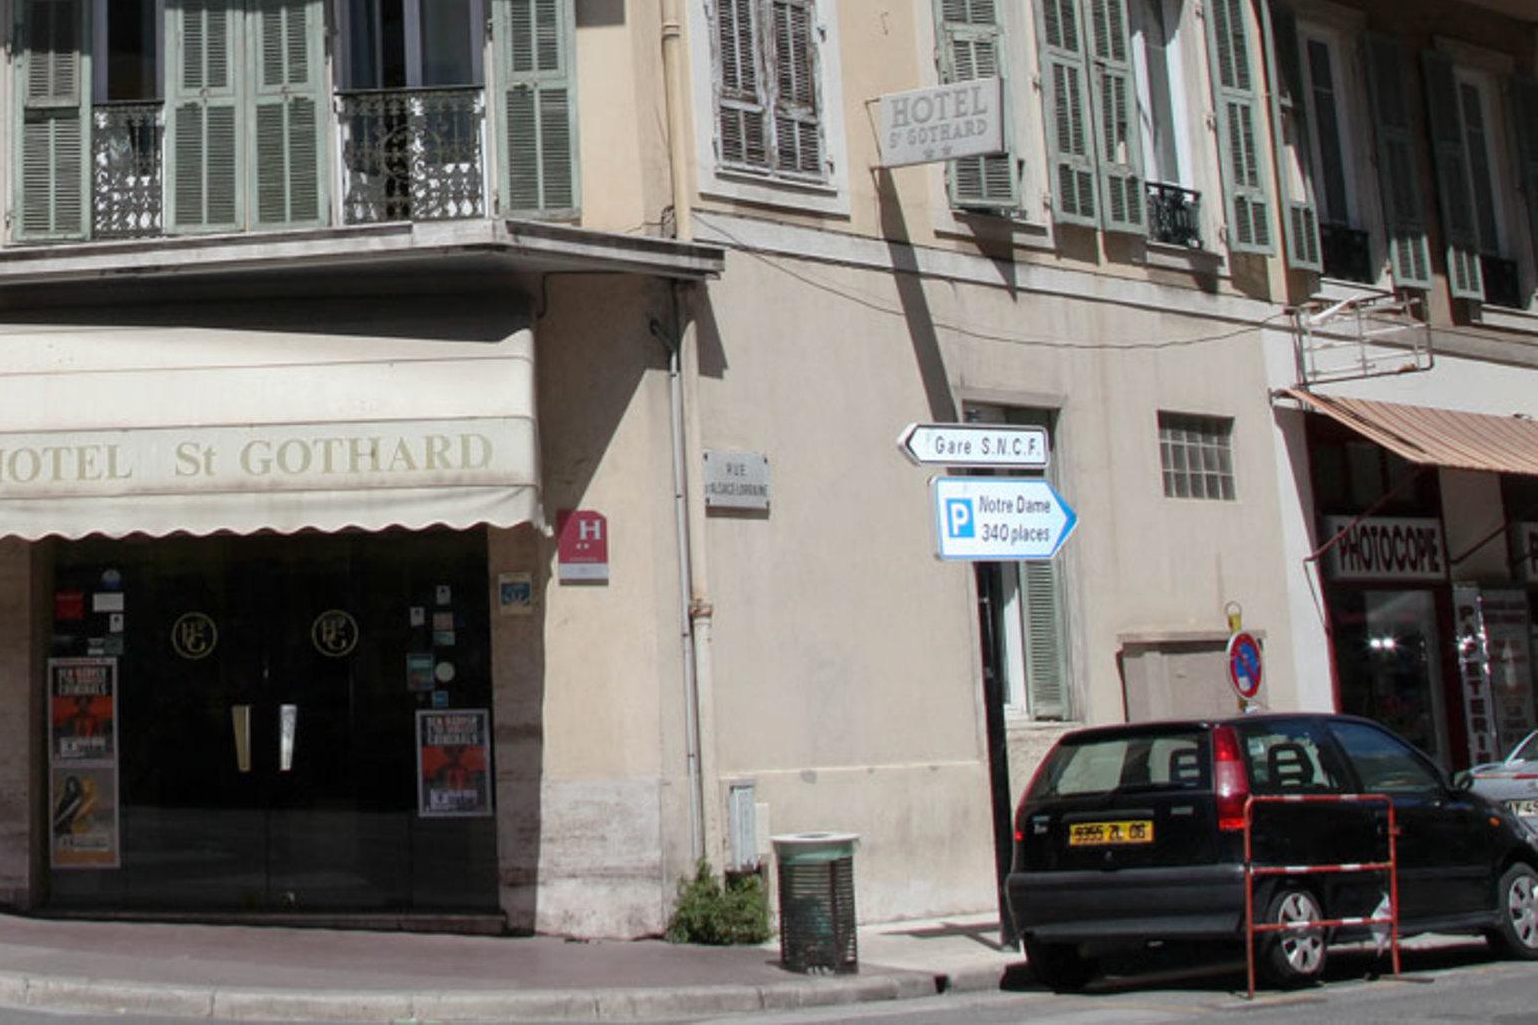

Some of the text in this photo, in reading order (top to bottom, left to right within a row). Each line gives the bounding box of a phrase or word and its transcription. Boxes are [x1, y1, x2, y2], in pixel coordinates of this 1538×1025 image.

[890, 86, 988, 128] HOTEL
[907, 118, 988, 145] GOTHARD
[175, 441, 218, 478] St
[239, 432, 494, 477] GOTHARD
[935, 435, 1041, 456] Gare S.N.C.F.
[979, 495, 1052, 514] Notre Dame
[579, 519, 601, 540] H
[950, 502, 969, 536] P
[981, 524, 1050, 545] 340 places
